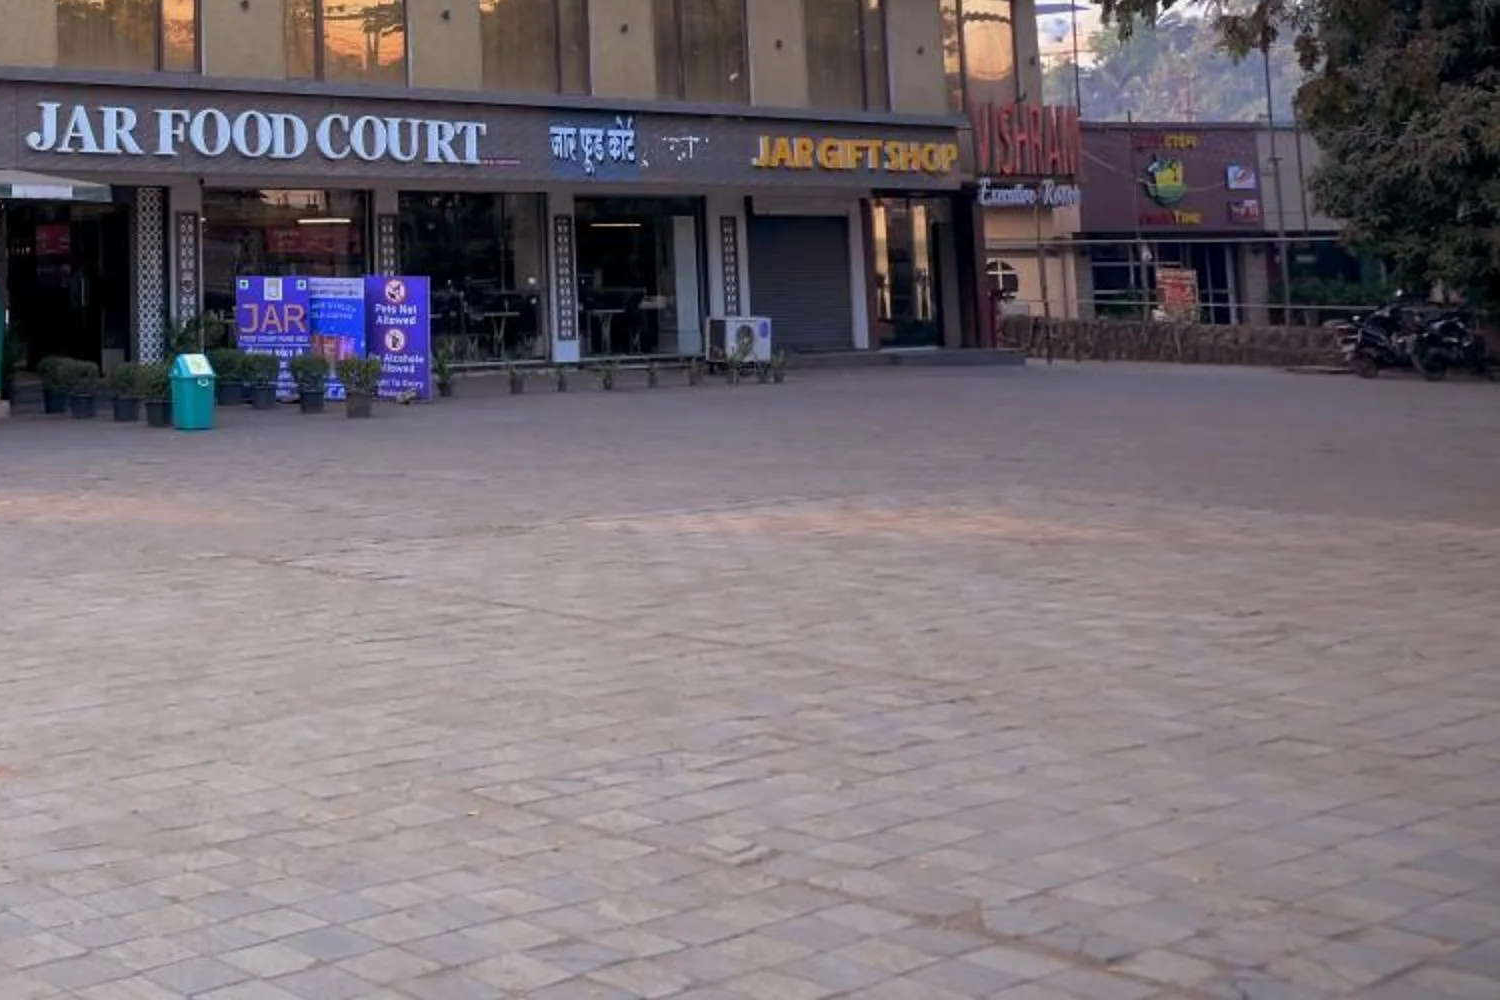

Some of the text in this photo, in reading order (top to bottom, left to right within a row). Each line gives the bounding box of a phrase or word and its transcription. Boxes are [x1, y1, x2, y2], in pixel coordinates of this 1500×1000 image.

[25, 101, 487, 166] JAR FOOD COURT
[752, 135, 959, 173] JAR GIFT SHOP
[240, 303, 307, 333] JAR
